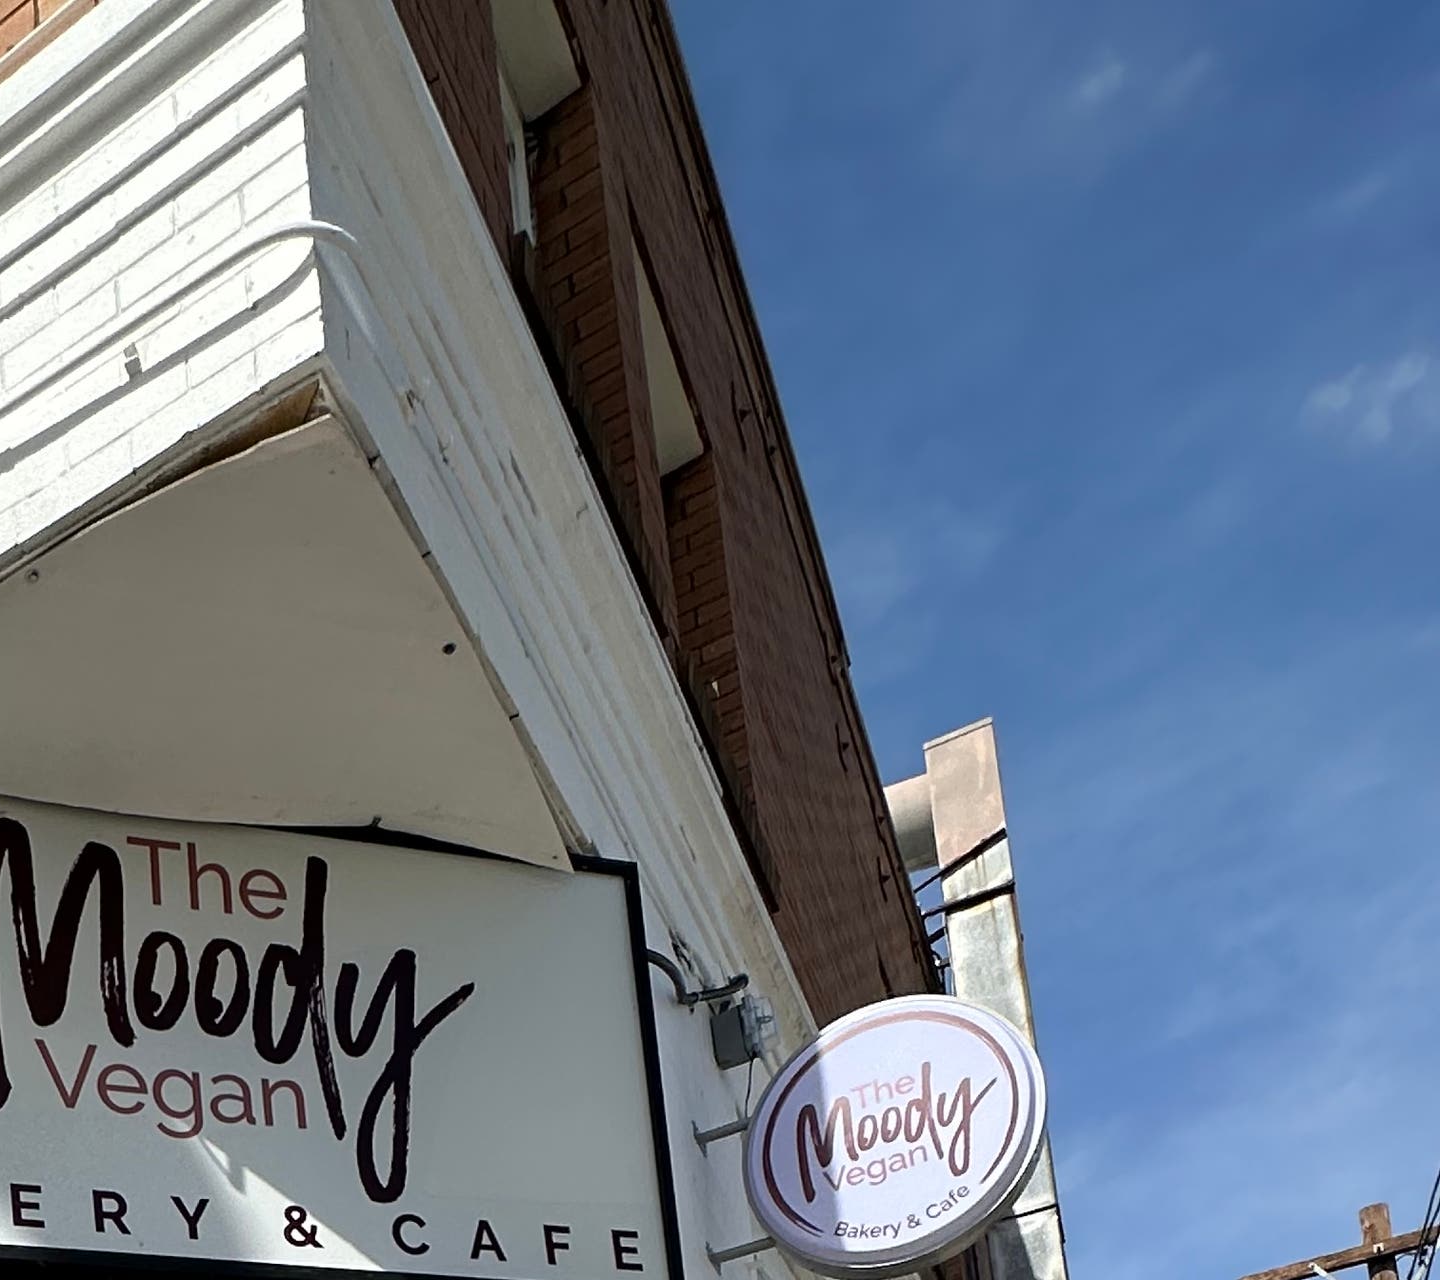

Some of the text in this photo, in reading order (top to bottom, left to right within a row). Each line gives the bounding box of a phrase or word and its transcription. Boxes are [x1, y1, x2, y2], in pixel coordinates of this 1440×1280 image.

[126, 836, 287, 920] The
[35, 1039, 307, 1139] Vegan
[850, 1075, 916, 1109] The
[796, 1061, 998, 1203] Moody
[822, 1144, 928, 1192] Vegan
[282, 1205, 323, 1248] &
[392, 1213, 644, 1272] CAFE
[834, 1185, 970, 1239] Bakery & Cafe
